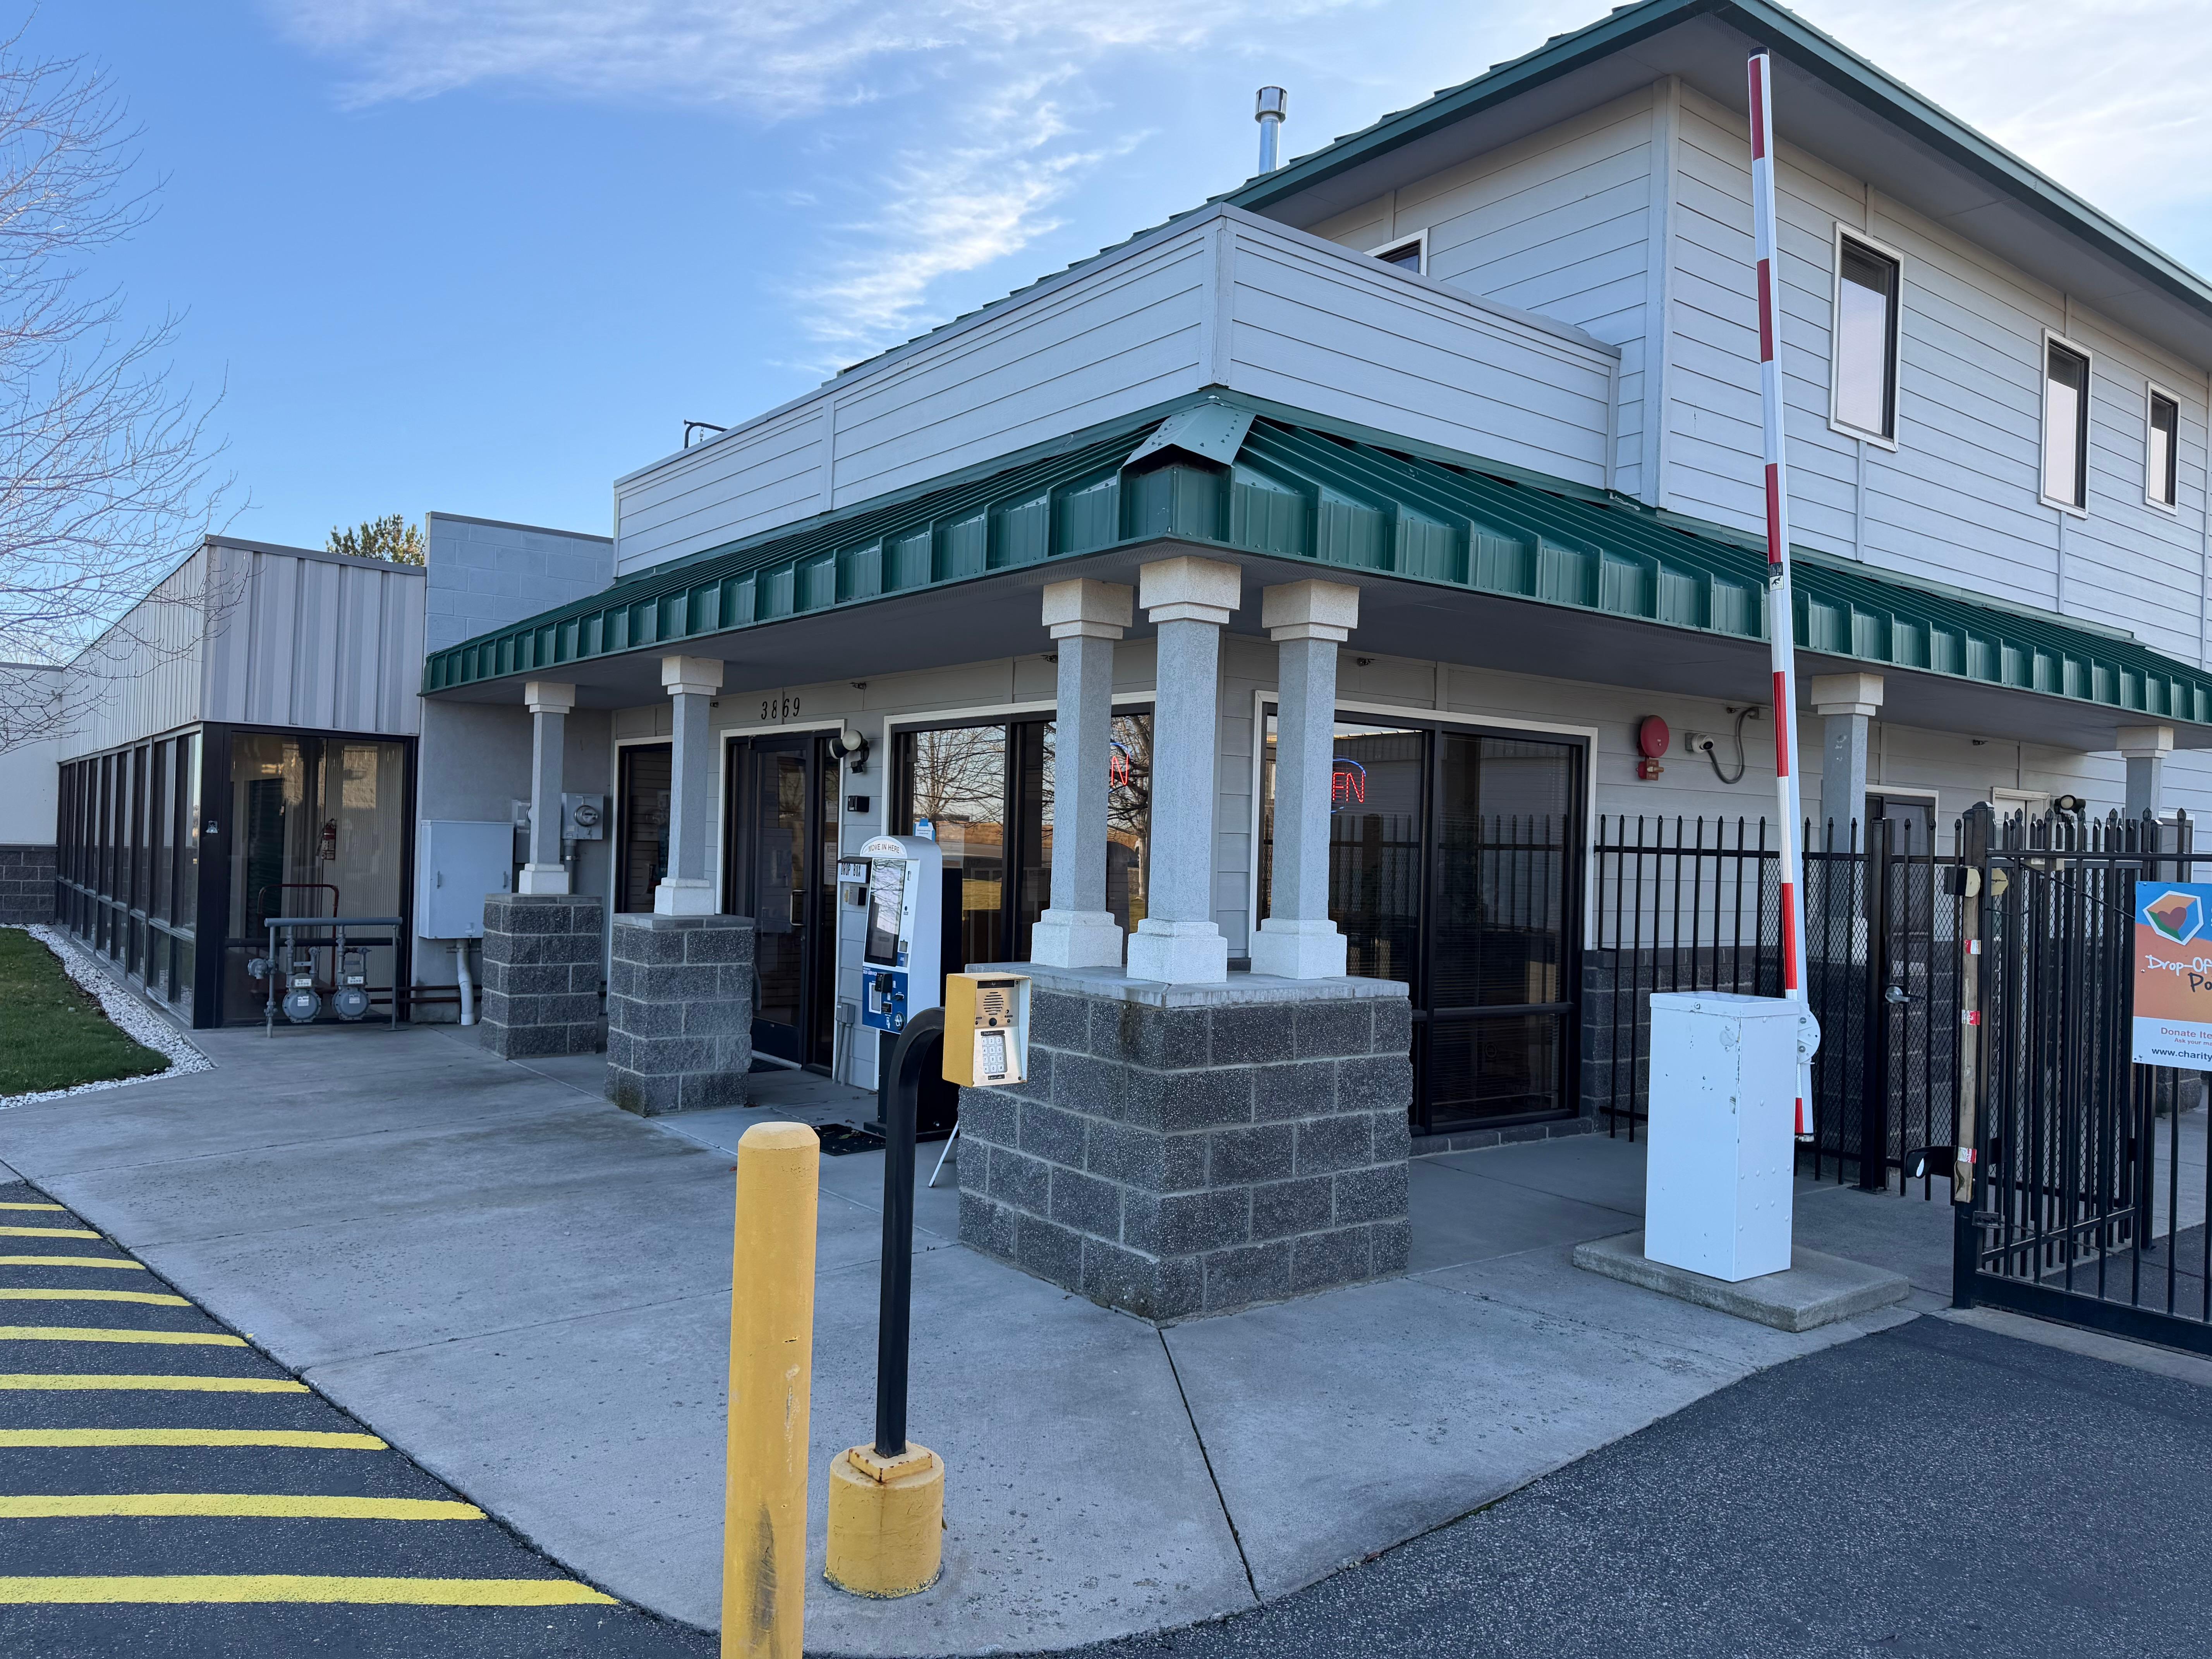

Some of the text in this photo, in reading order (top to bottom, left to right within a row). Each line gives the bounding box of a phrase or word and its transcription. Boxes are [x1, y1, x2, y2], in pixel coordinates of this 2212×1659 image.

[761, 697, 800, 720] 3869
[869, 843, 880, 852] MOVE
[888, 845, 900, 854] HERE
[841, 863, 851, 876] DROP
[2161, 1027, 2196, 1037] Donate
